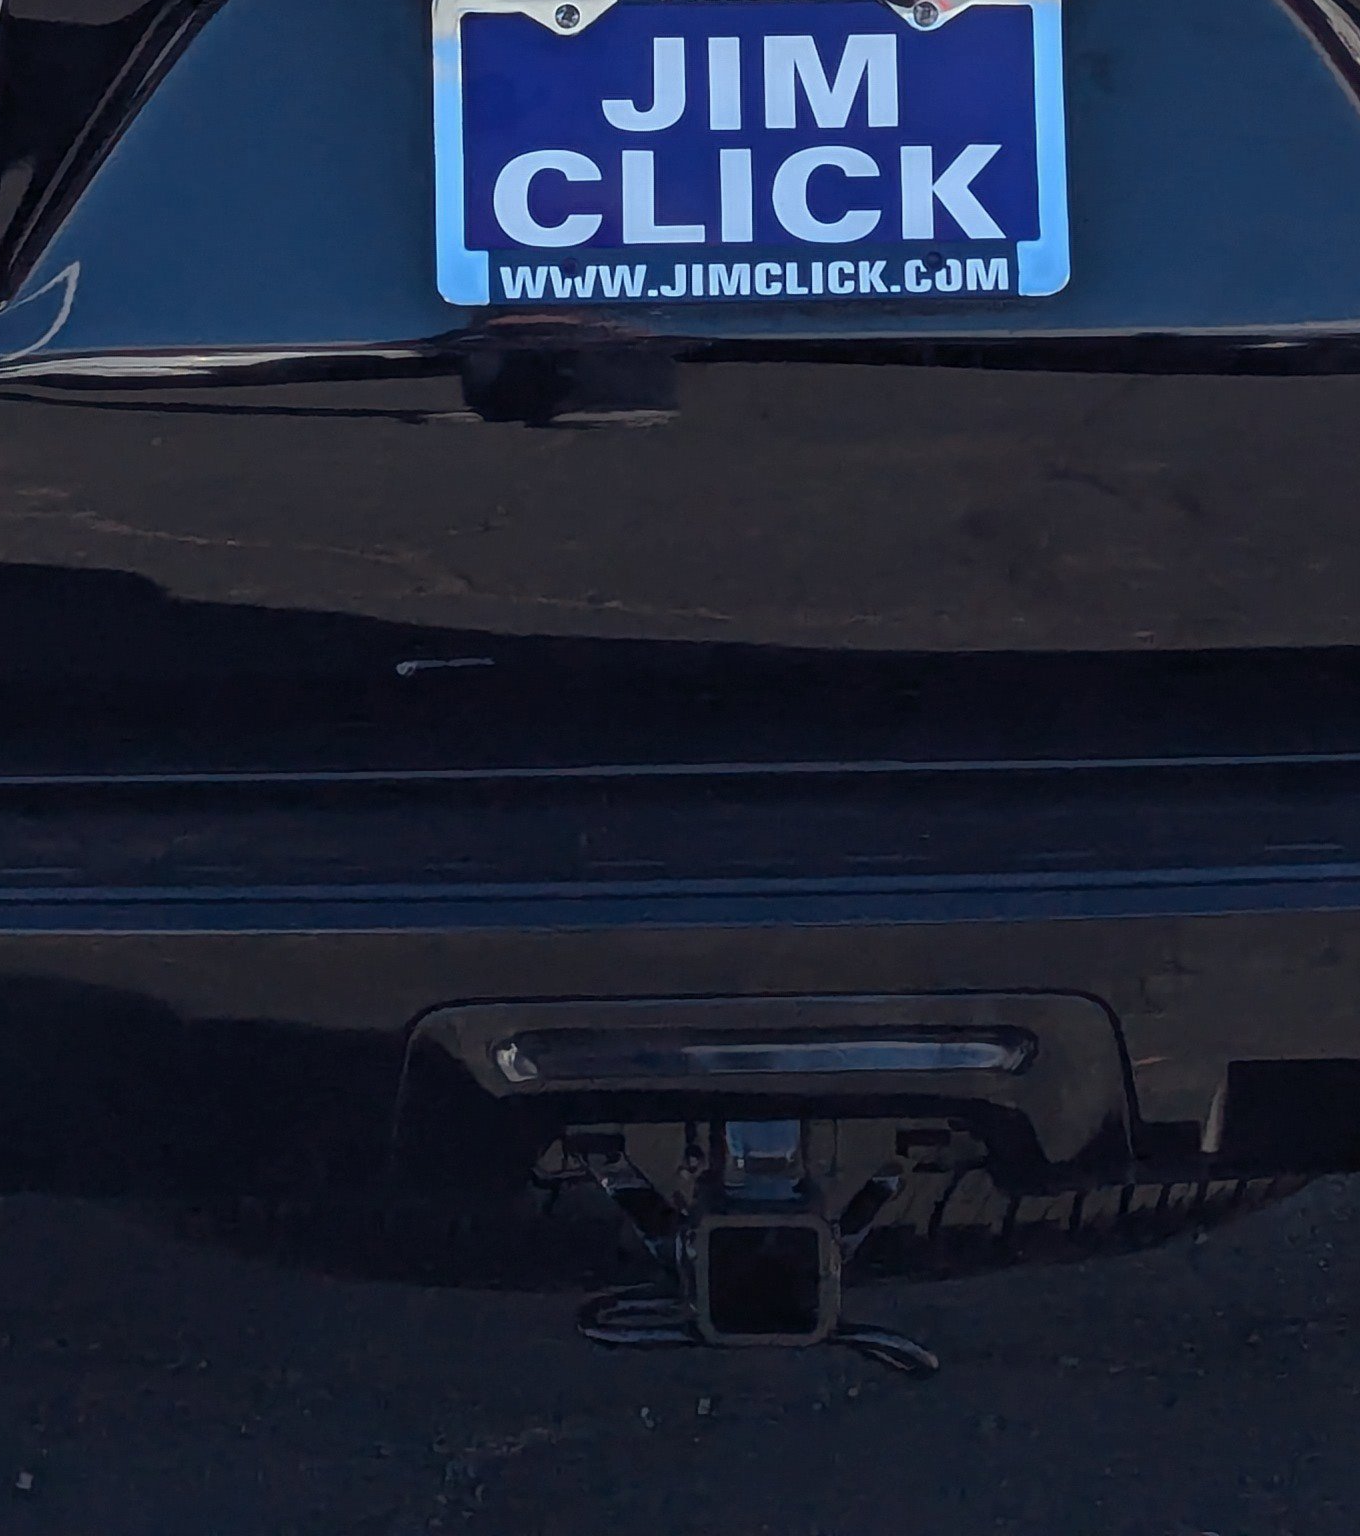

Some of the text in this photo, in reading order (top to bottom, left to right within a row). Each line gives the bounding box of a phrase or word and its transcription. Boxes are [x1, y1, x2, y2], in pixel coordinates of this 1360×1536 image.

[601, 33, 900, 133] JIM
[493, 143, 1007, 247] CLICK
[499, 257, 1010, 300] WWW.JIMCLICK.COM
